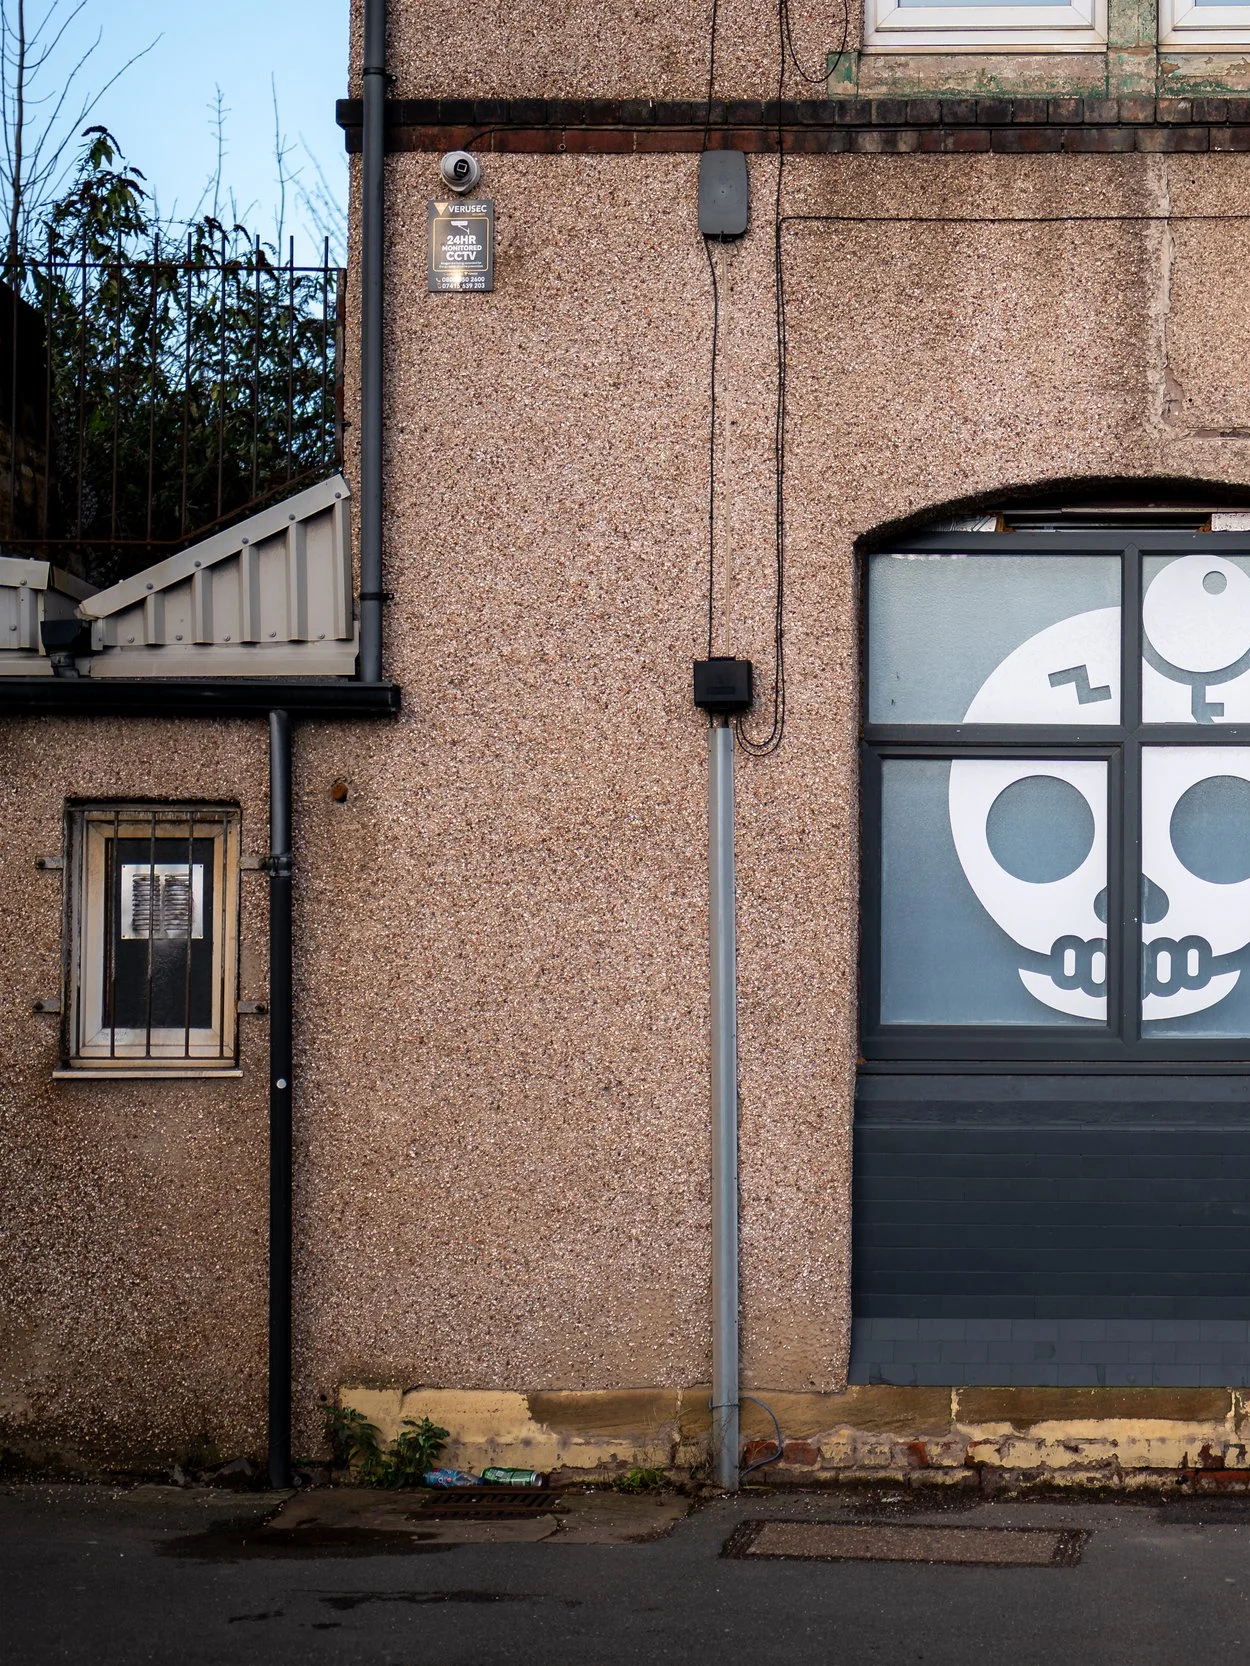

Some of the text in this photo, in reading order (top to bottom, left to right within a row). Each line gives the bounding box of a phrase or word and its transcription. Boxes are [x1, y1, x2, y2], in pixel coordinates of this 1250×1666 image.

[448, 205, 487, 213] VERUSEC
[446, 235, 476, 245] 24HR
[446, 251, 476, 261] CCTV
